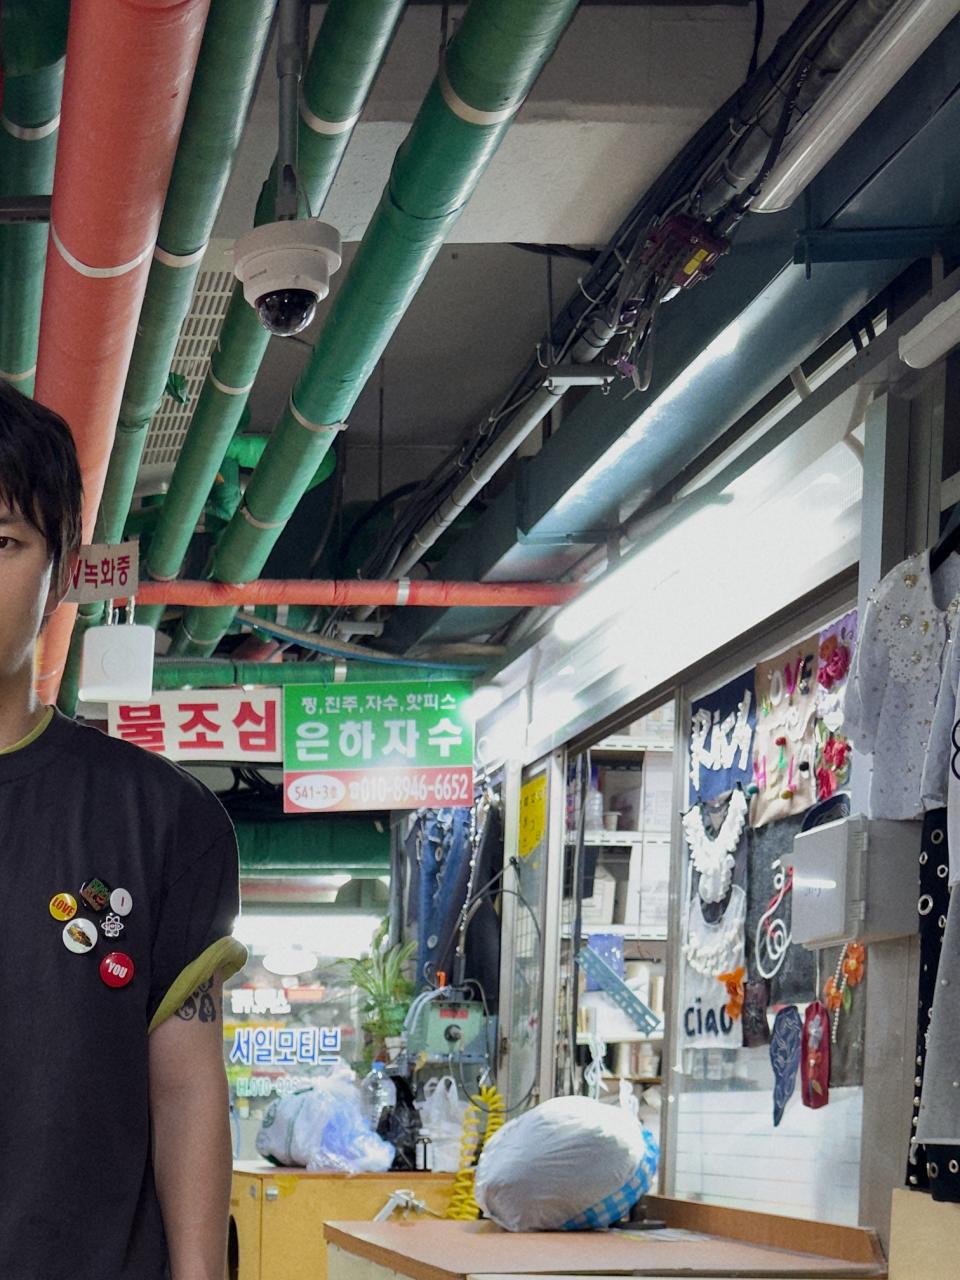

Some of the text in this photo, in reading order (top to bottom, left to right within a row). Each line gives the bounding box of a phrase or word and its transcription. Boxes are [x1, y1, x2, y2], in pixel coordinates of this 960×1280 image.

[117, 700, 276, 752] 불조심
[296, 717, 463, 762] 은하자수
[51, 897, 75, 917] LOVE
[107, 962, 128, 978] YOU
